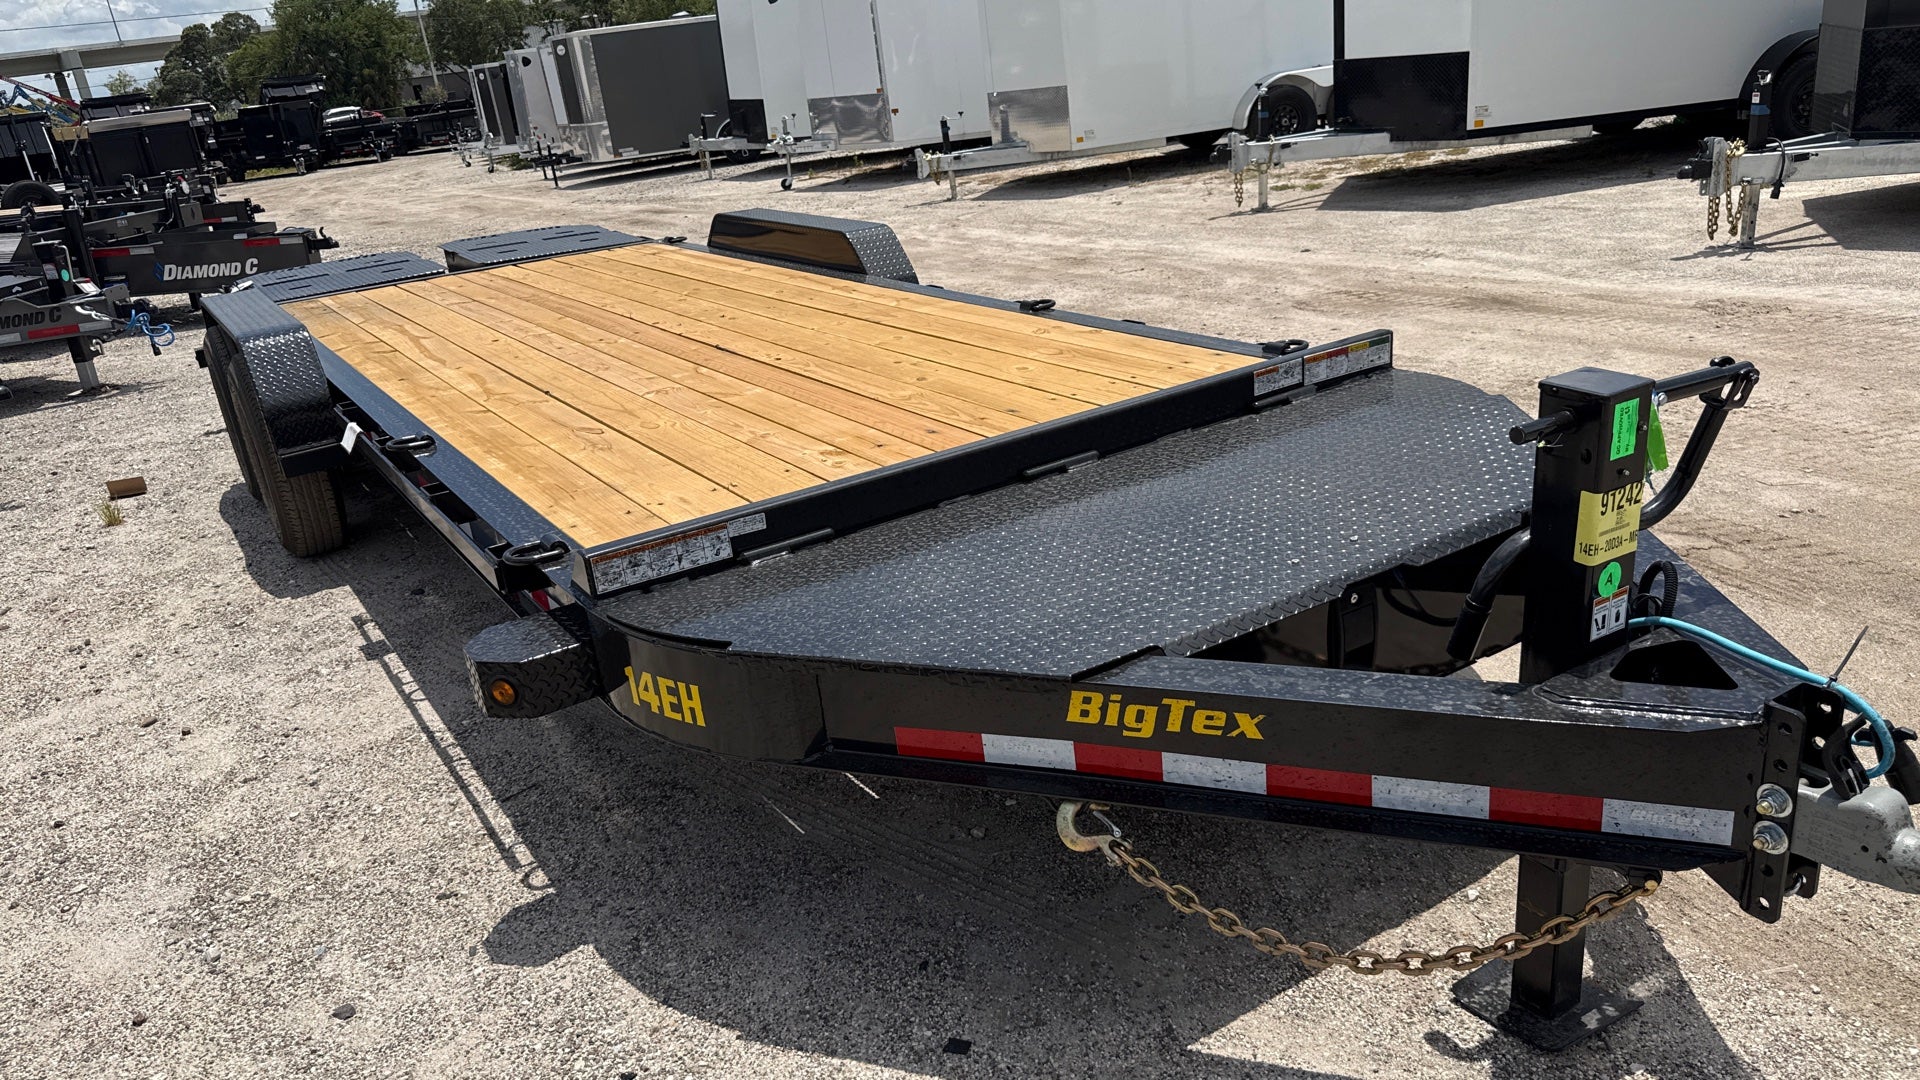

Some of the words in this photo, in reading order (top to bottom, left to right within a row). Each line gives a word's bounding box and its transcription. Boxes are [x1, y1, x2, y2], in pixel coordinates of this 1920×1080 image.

[163, 262, 242, 281] DIAMOND
[245, 257, 259, 275] C
[49, 307, 62, 323] C
[1617, 407, 1625, 444] APPROVED
[1604, 572, 1613, 586] A
[624, 665, 706, 728] 14EH
[1065, 690, 1267, 740] BigTex
